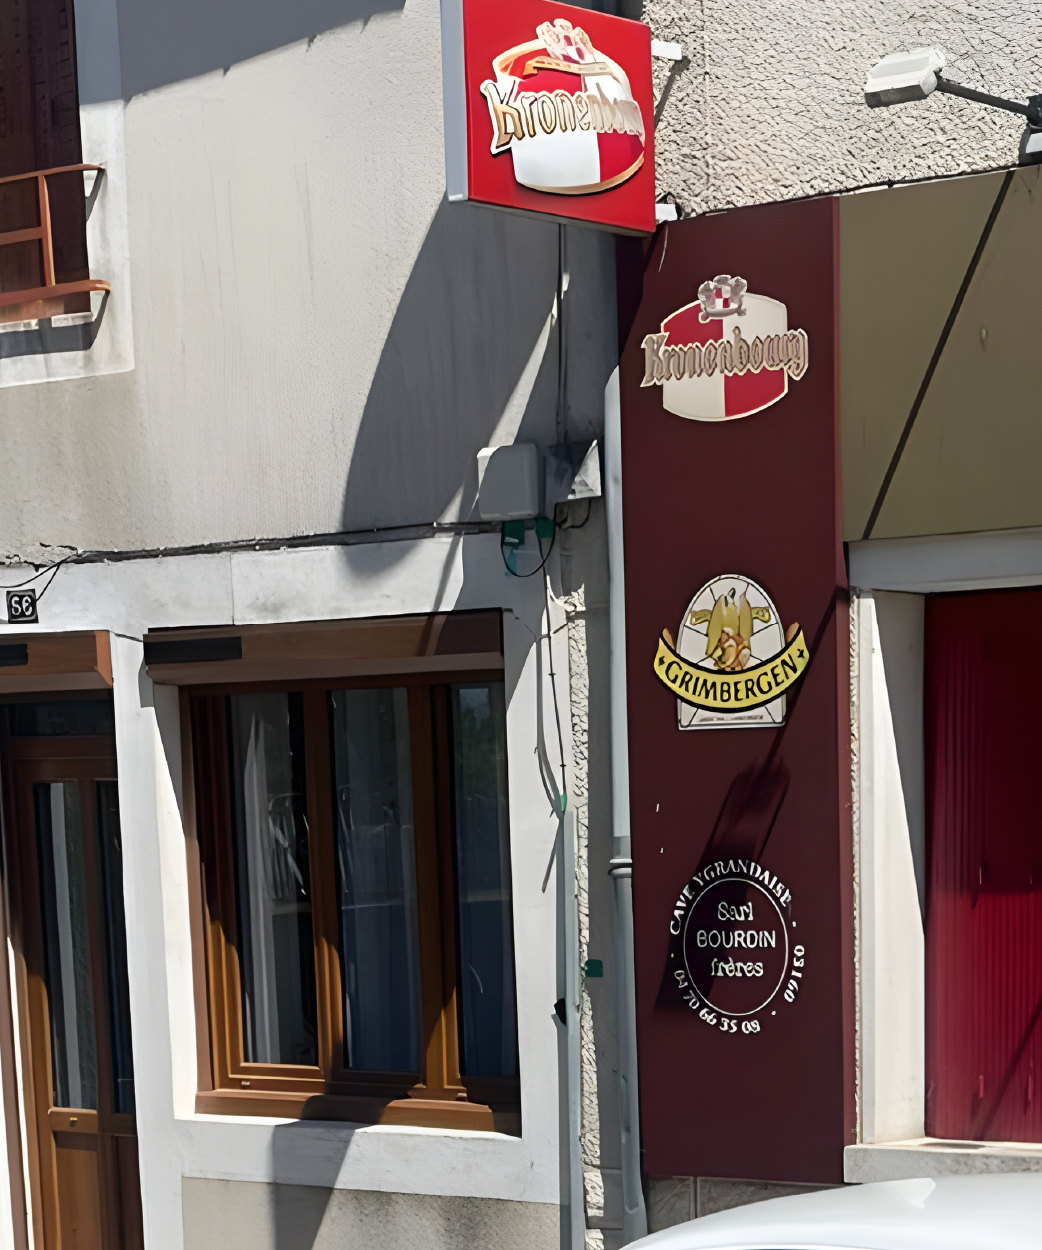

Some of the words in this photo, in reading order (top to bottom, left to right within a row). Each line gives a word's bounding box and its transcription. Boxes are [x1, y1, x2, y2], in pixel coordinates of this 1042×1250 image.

[664, 653, 798, 703] GRIMBERGEN
[670, 884, 696, 935] CAVE
[696, 929, 776, 949] BOURDIN
[683, 990, 700, 1010] 70
[699, 1007, 718, 1026] 66
[719, 1017, 738, 1033] 35
